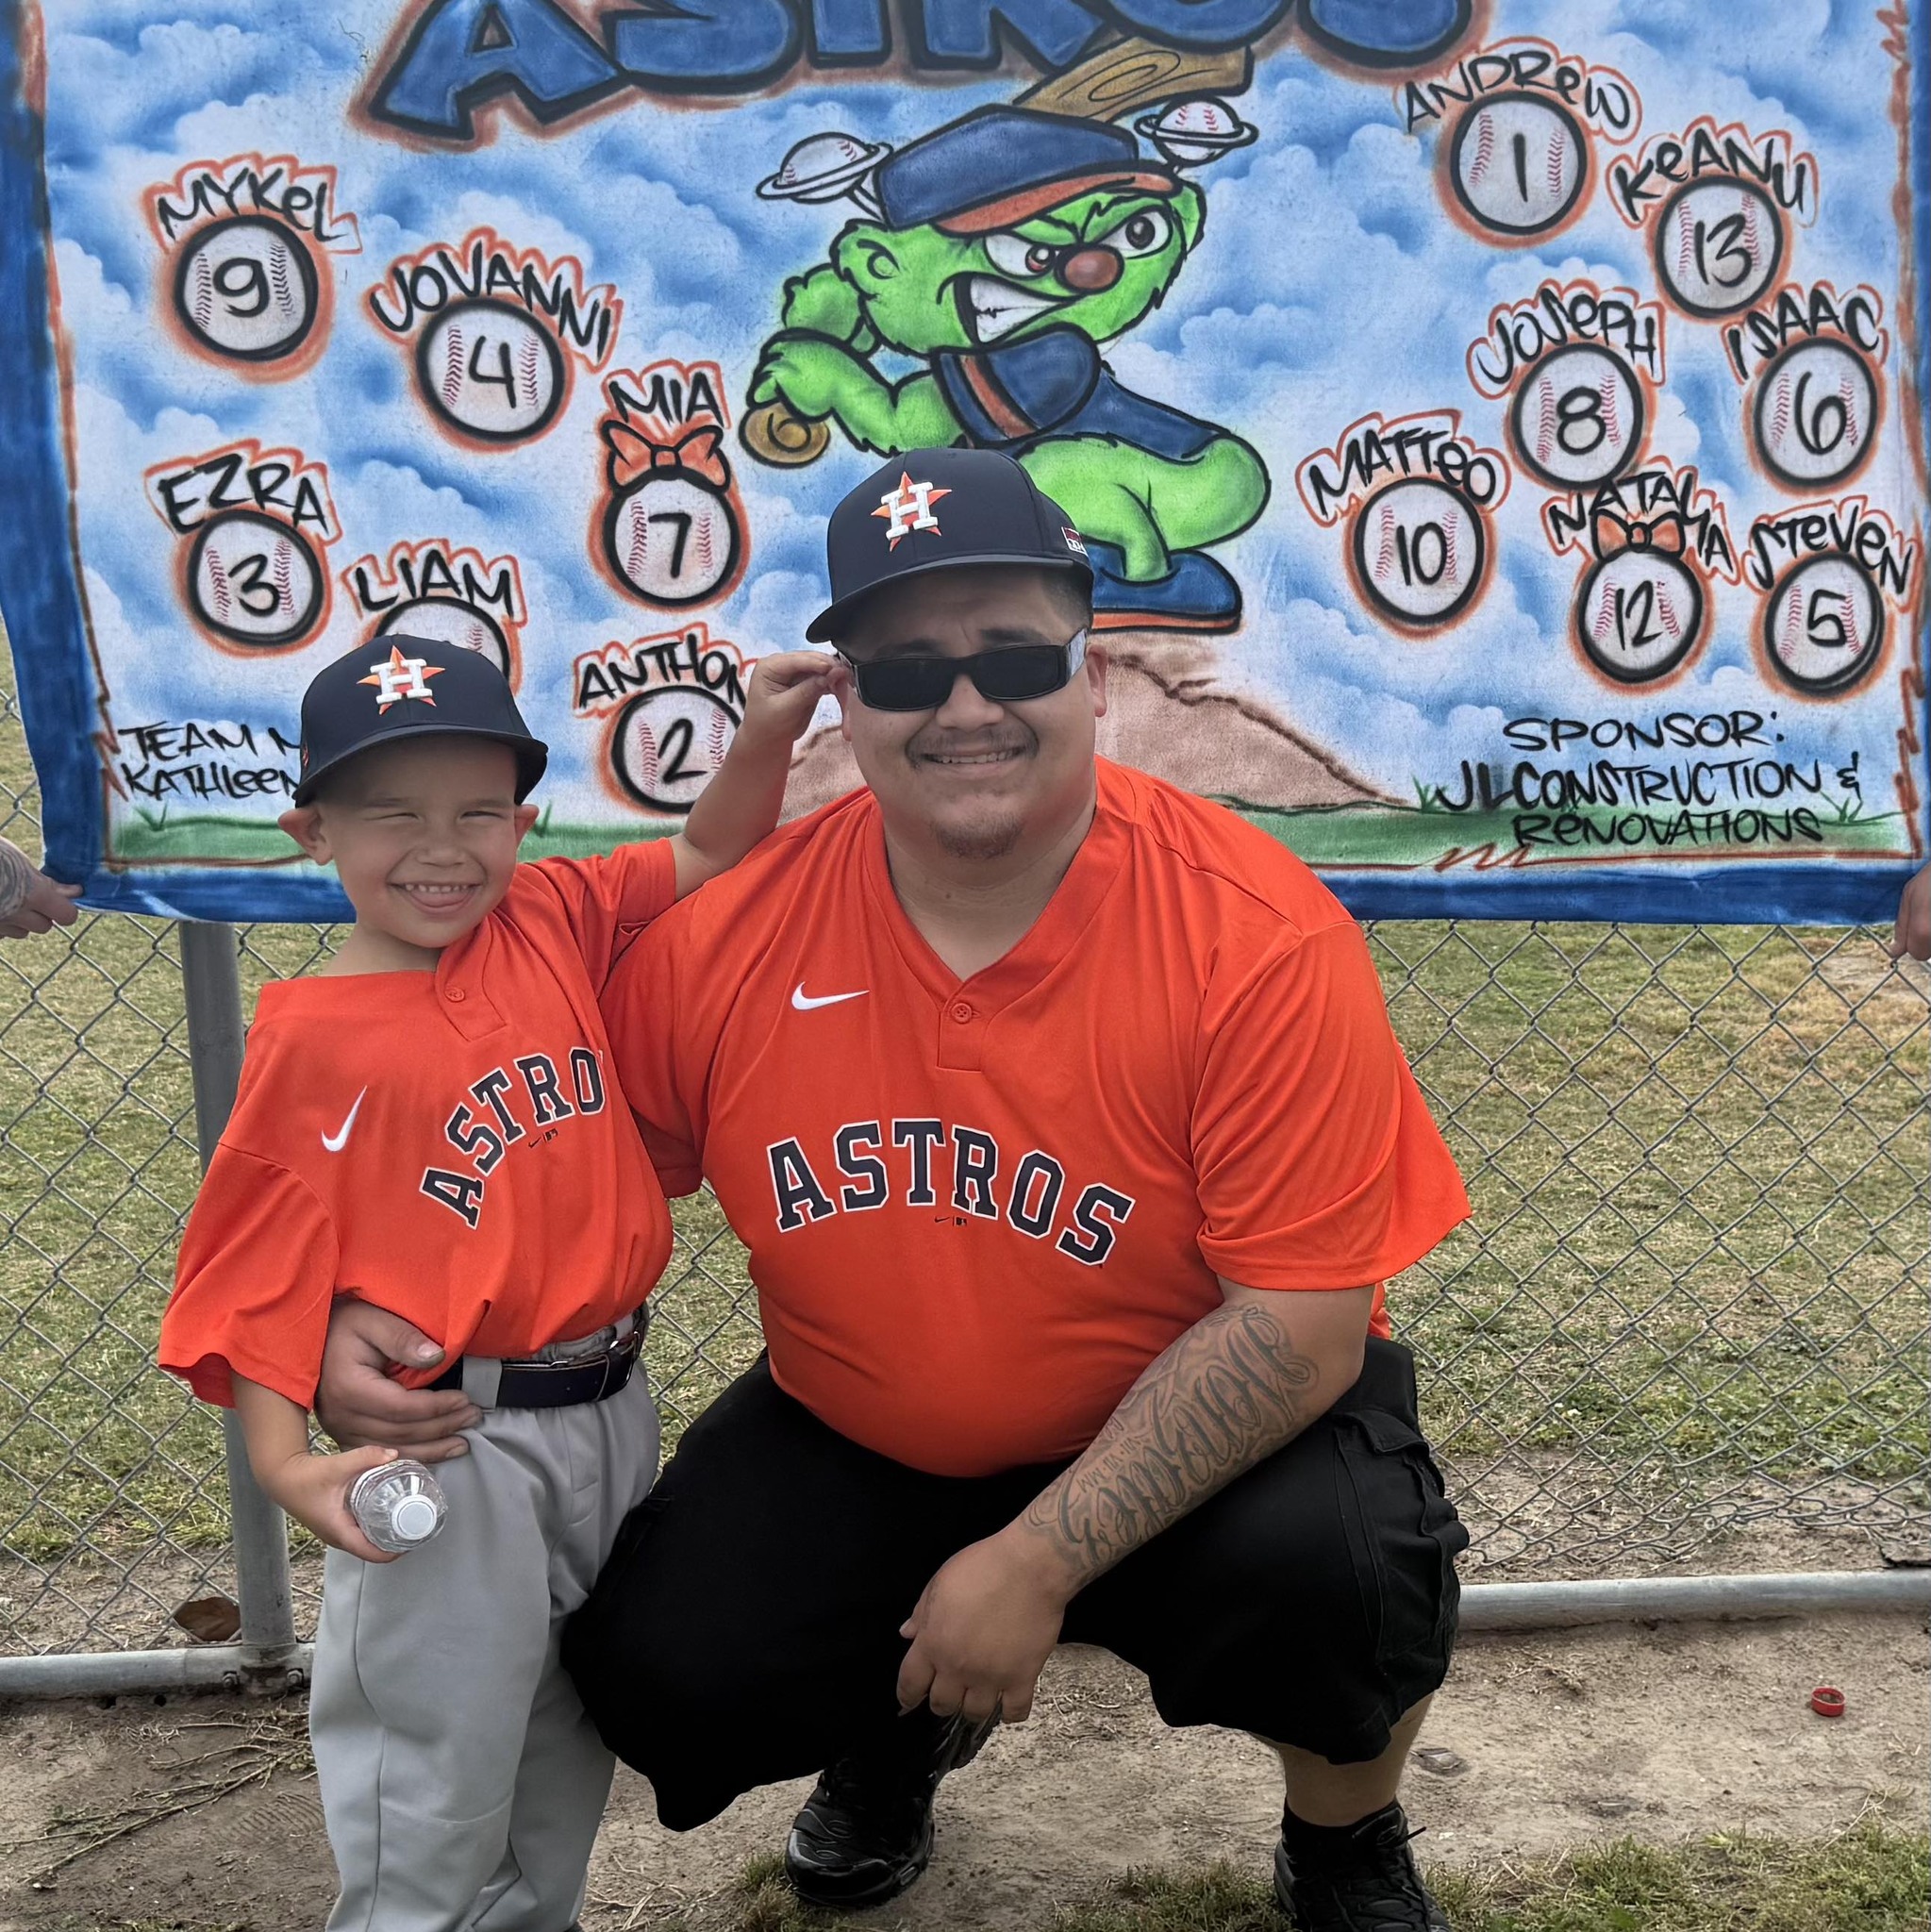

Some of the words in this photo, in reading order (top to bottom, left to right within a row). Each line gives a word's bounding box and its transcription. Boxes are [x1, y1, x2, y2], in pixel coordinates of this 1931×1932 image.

[1513, 133, 1528, 202] 1
[1694, 213, 1753, 288] 13
[213, 258, 265, 317] 9
[371, 239, 610, 365] JOVANNI
[1730, 288, 1882, 379] ISAAC
[470, 335, 516, 408] 4
[609, 365, 724, 426] MIA
[1556, 386, 1606, 456] 8
[1794, 372, 1846, 456] 6
[158, 454, 328, 534] EZRA
[881, 482, 938, 540] H
[649, 512, 691, 577] 7
[1395, 520, 1448, 586] 10
[229, 555, 279, 617] 3
[356, 548, 515, 615] LIAM
[1614, 580, 1664, 651] 12
[1807, 590, 1846, 646] 5
[370, 658, 432, 704] H
[118, 721, 258, 761] TEAM
[658, 718, 707, 784] 2
[1503, 710, 1787, 752] SPONSOR:
[767, 1118, 1136, 1266] ASTROS
